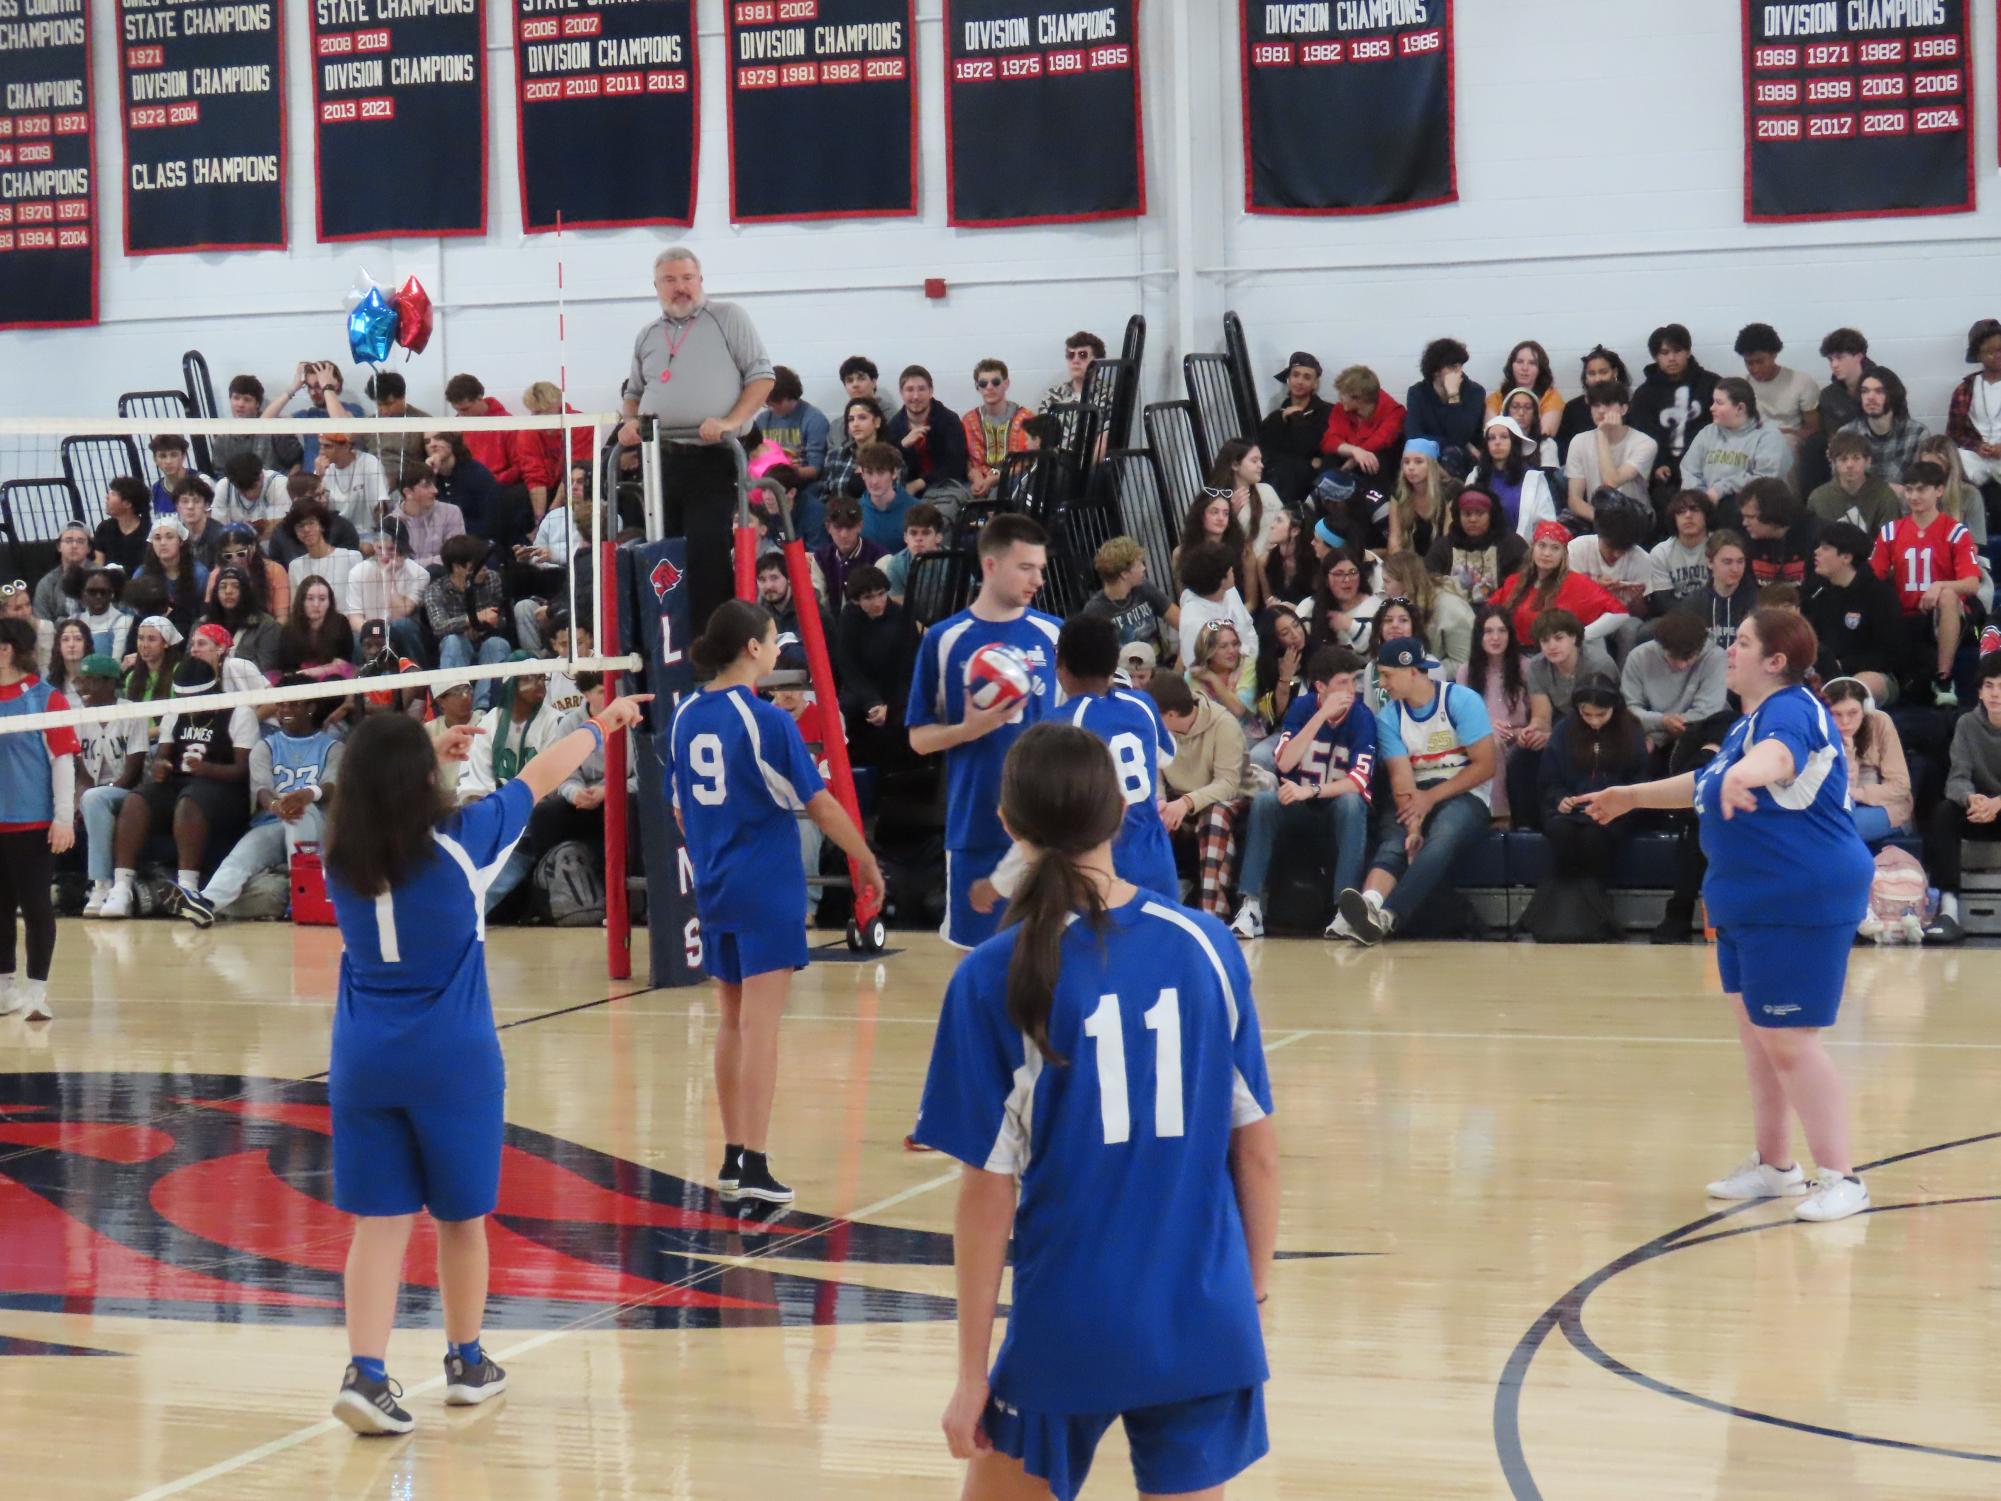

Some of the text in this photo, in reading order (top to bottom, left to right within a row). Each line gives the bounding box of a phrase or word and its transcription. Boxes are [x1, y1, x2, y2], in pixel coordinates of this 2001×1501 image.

[0, 0, 18, 17] SS
[126, 4, 270, 40] STATE CHAMPIONS
[318, 0, 369, 24] STATE
[738, 1, 814, 21] 1981 2002
[1266, 0, 1426, 34] DIVISION CHAMPIONS
[1765, 0, 1944, 36] DIVISION CHAMPIONS
[0, 18, 84, 49] CHAMPIONS
[524, 18, 598, 37] 2006 2007
[741, 22, 901, 59] DIVISION CHAMPIONS
[965, 8, 1115, 50] DIVISION CHAMPIONS
[131, 49, 160, 64] 1971
[321, 33, 387, 52] 2008 2019
[529, 35, 681, 72] DIVISION CHAMPIONS
[1256, 32, 1438, 62] 1981 1982 1983 1985
[1757, 39, 1956, 66] 1969 1971 1982 1986
[325, 55, 473, 91] DIVISION CHAMPIONS
[741, 61, 902, 85] 1979 1981 1982 2002
[957, 48, 1127, 78] 1972 1975 1981 1985
[7, 80, 82, 109] CHAMPIONS
[132, 65, 269, 100] DIVISION CHAMPIONS
[527, 75, 684, 98] 2007 2010 2011 2013
[1758, 74, 1957, 101] 1989 1999 2003 2006
[132, 106, 197, 125] 1972 2004
[324, 101, 391, 119] 2013 2021
[1759, 111, 1958, 136] 2008 2017 2020 2024
[18, 118, 50, 134] 1970
[58, 116, 86, 131] 1971
[3, 168, 87, 197] CHAMPIONS
[132, 156, 277, 189] CLASS CHAMPIONS
[20, 206, 52, 220] 1970
[59, 203, 86, 217] 1971
[20, 232, 54, 246] 1984
[60, 231, 87, 245] 2004
[1669, 565, 1708, 585] LINCOL
[1904, 547, 1932, 591] 11
[181, 726, 214, 743] JAMES
[688, 733, 727, 806] 9
[1109, 732, 1151, 804] 8
[1356, 753, 1373, 776] 5
[374, 890, 402, 963] 1
[1084, 987, 1185, 1145] 11
